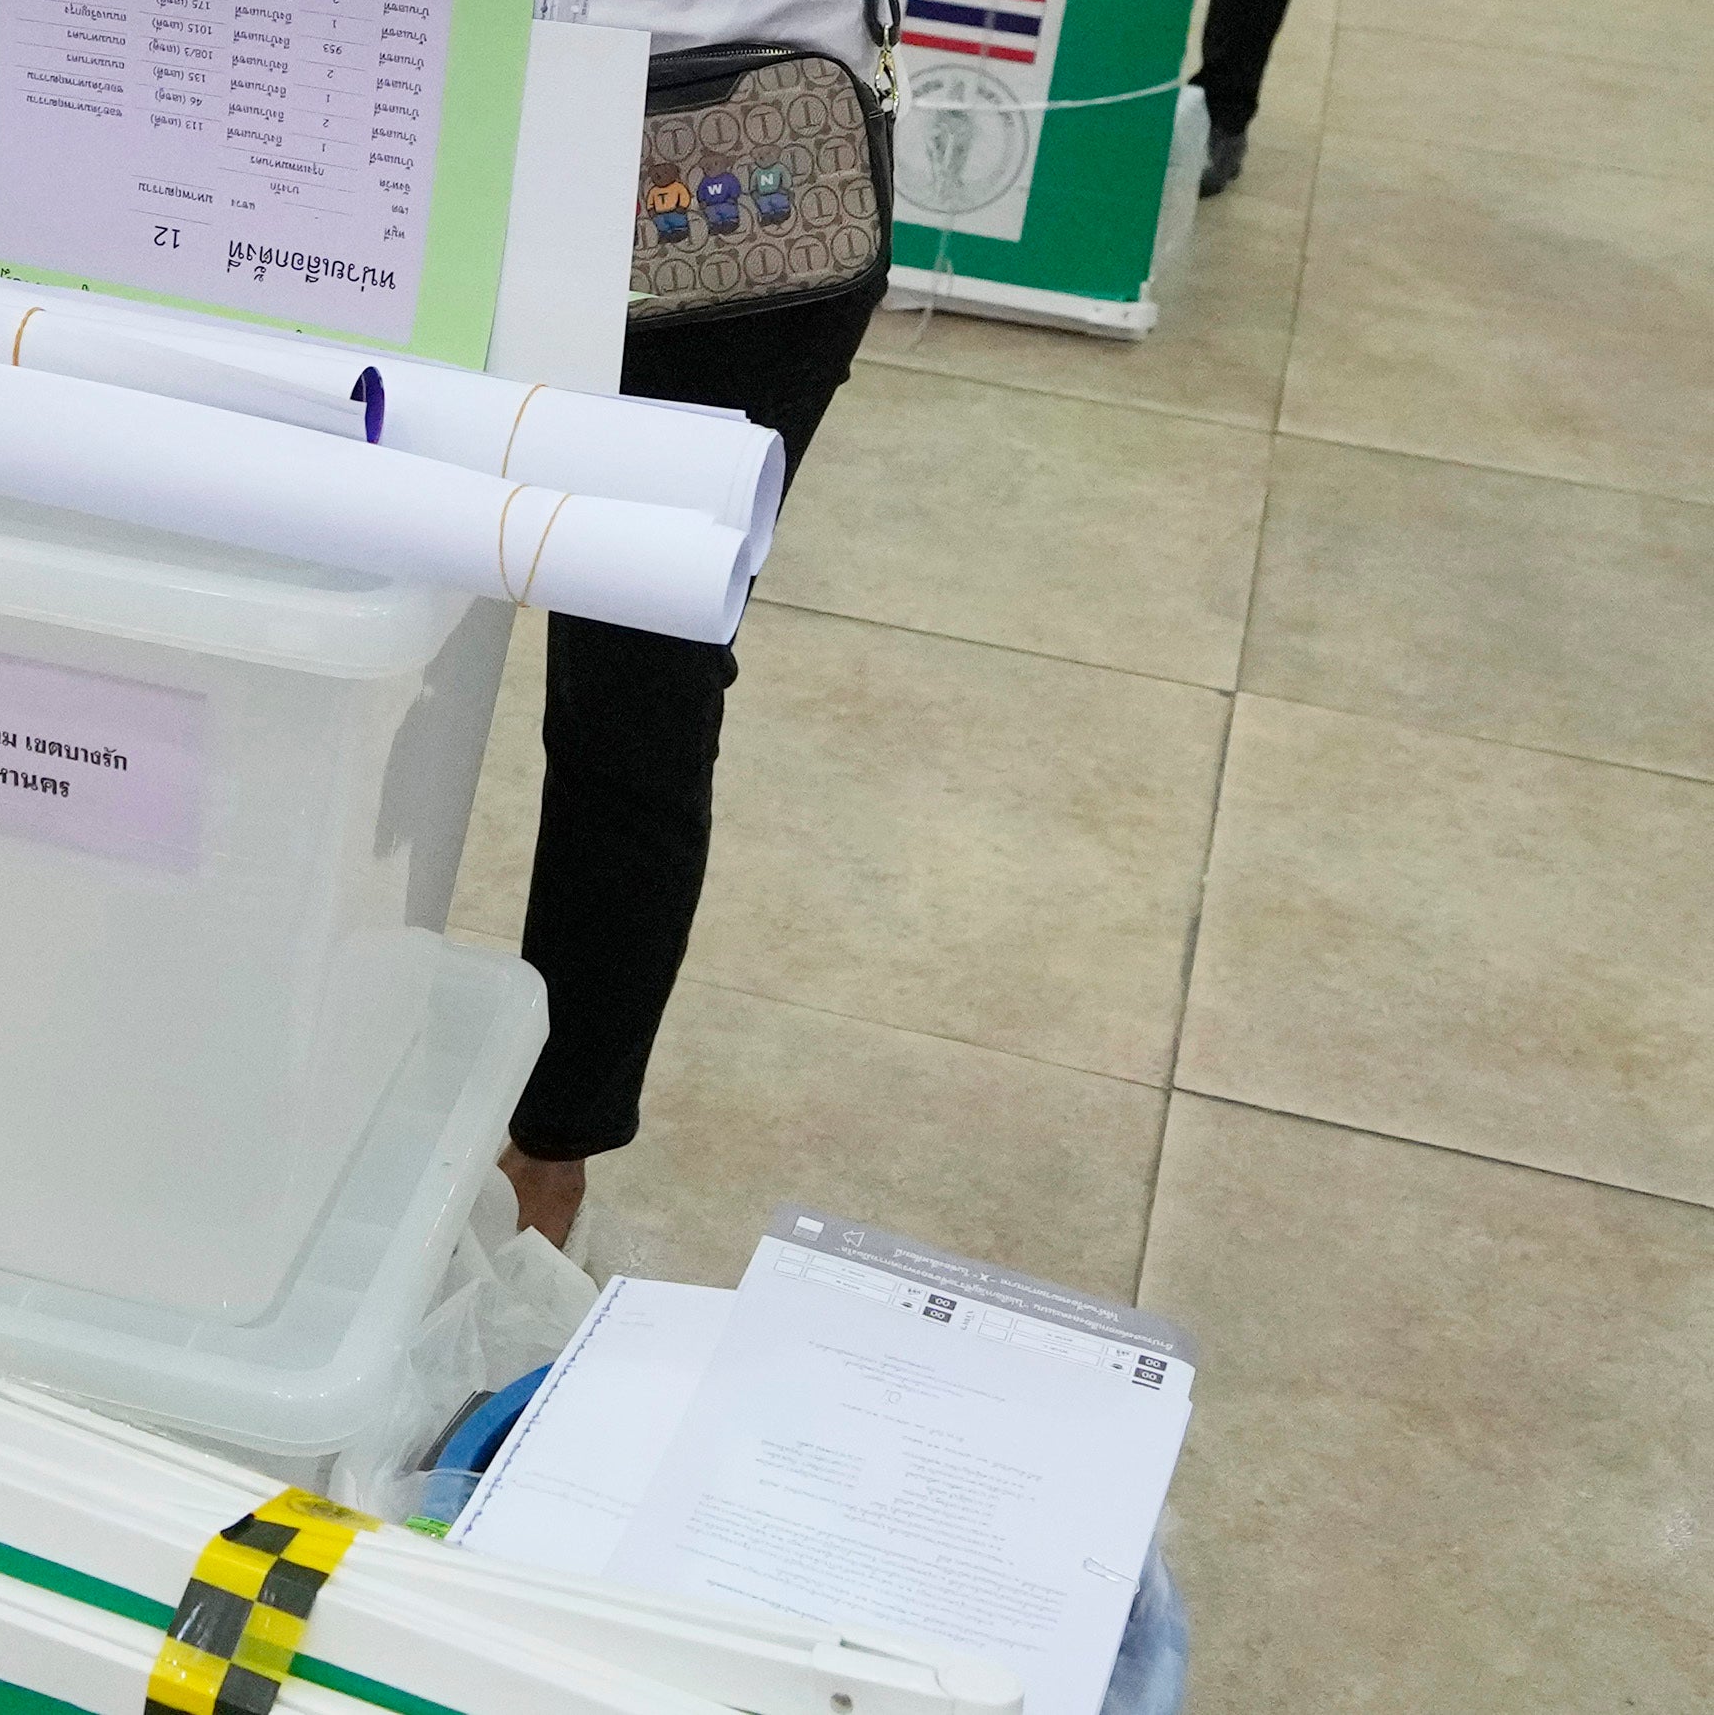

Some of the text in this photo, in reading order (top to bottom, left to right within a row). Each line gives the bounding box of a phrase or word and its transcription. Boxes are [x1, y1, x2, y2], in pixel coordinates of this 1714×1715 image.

[192, 0, 211, 10] 175
[187, 23, 212, 35] 1015
[332, 20, 337, 28] 1
[184, 47, 213, 60] 108/3
[322, 44, 342, 54] 953
[188, 72, 206, 83] 135
[327, 69, 333, 78] 2
[190, 97, 202, 107] 46
[326, 95, 330, 103] 1
[185, 120, 203, 131] 113
[323, 119, 329, 127] 2
[322, 143, 326, 152] 1
[250, 155, 411, 195] จังหวัด กรุงเทพมหานคร
[760, 173, 774, 186] N
[270, 182, 299, 196] บางรัก
[707, 184, 723, 195] W
[658, 193, 668, 204] T
[154, 226, 395, 292] หน่วยเลือกตั้งที่ 12
[26, 736, 129, 772] เขตบางรัก
